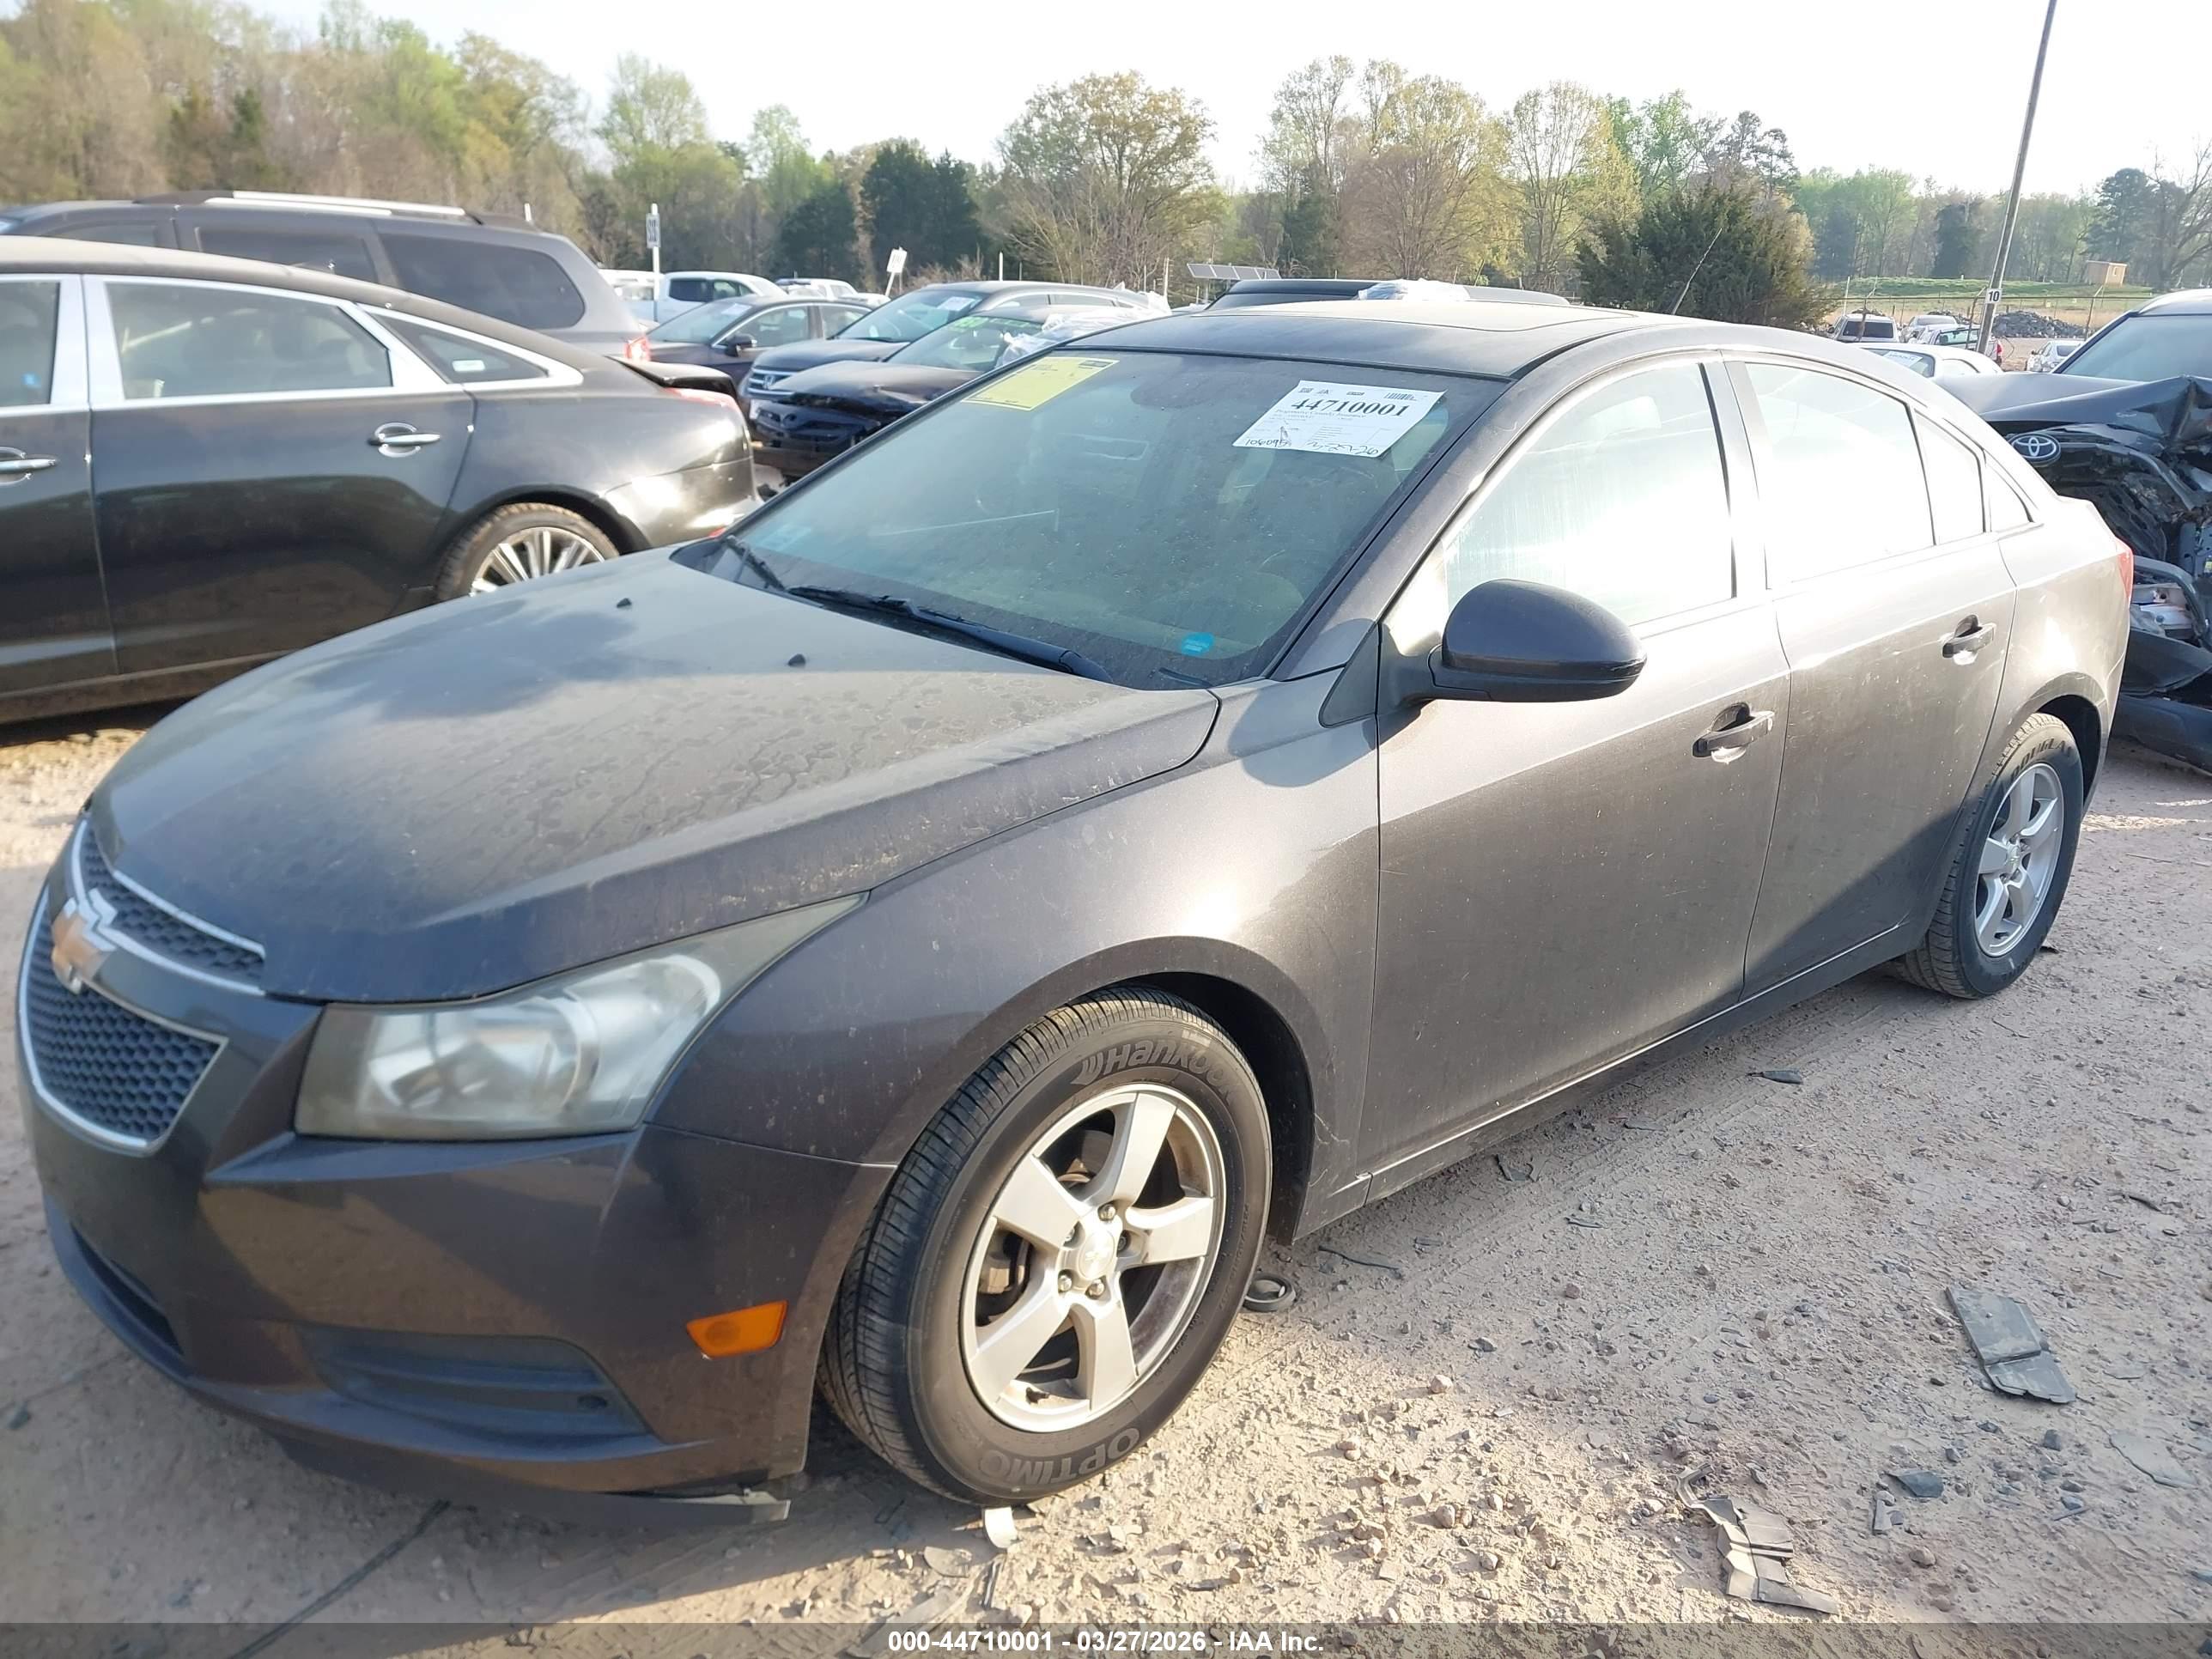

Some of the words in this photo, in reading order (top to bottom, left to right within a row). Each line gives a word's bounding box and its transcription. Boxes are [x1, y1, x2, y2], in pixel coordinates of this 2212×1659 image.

[1989, 291, 2000, 301] 10
[1291, 398, 1410, 417] 44710001
[980, 1428, 1140, 1485] OPTIMO
